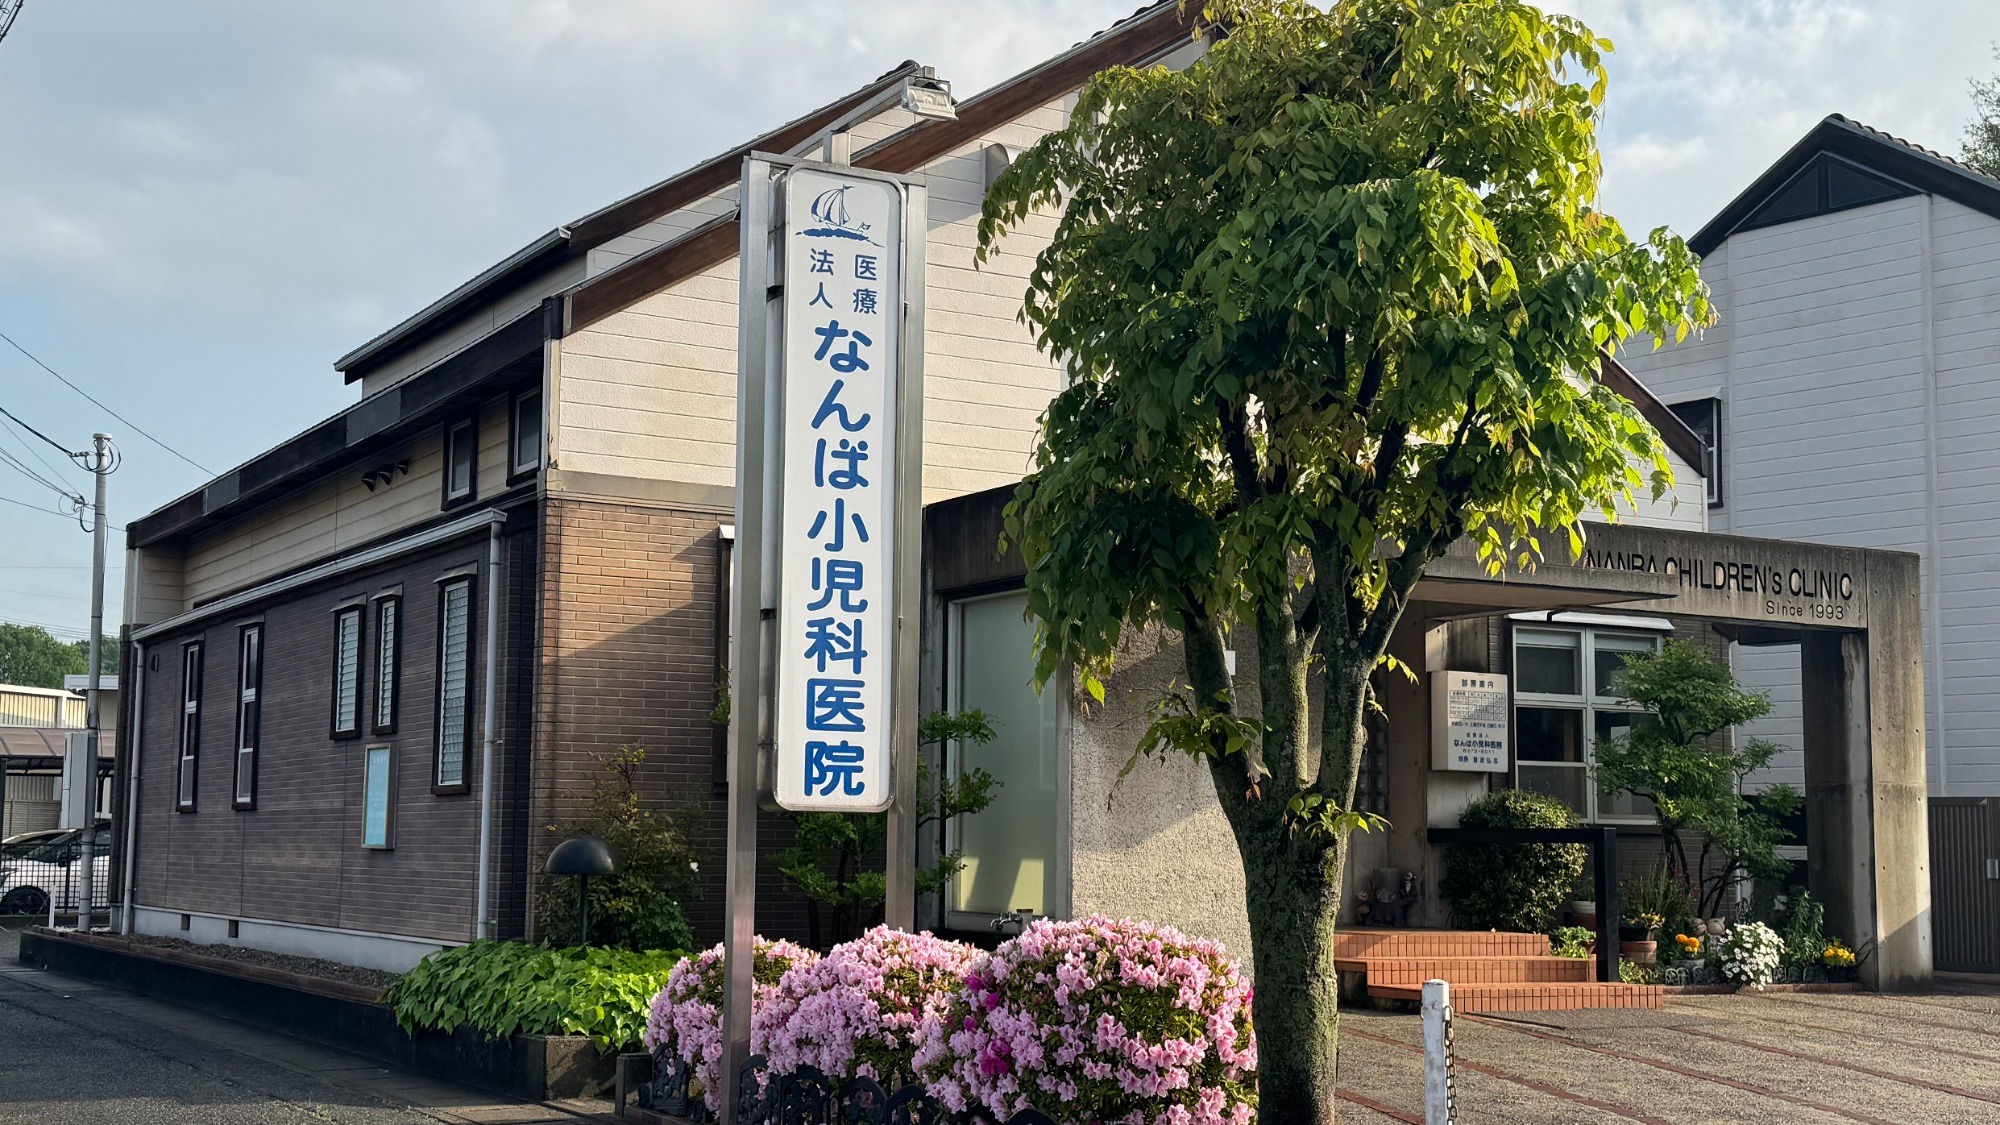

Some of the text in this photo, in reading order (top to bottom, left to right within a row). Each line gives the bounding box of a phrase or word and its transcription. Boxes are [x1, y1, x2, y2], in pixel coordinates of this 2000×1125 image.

[809, 248, 834, 309] 法人
[853, 254, 877, 315] 医療
[803, 319, 873, 797] なんば小児科医院
[1788, 567, 1853, 601] CLINIC
[1766, 600, 1844, 620] Since 1993
[1453, 739, 1503, 750] なんば小児科医院
